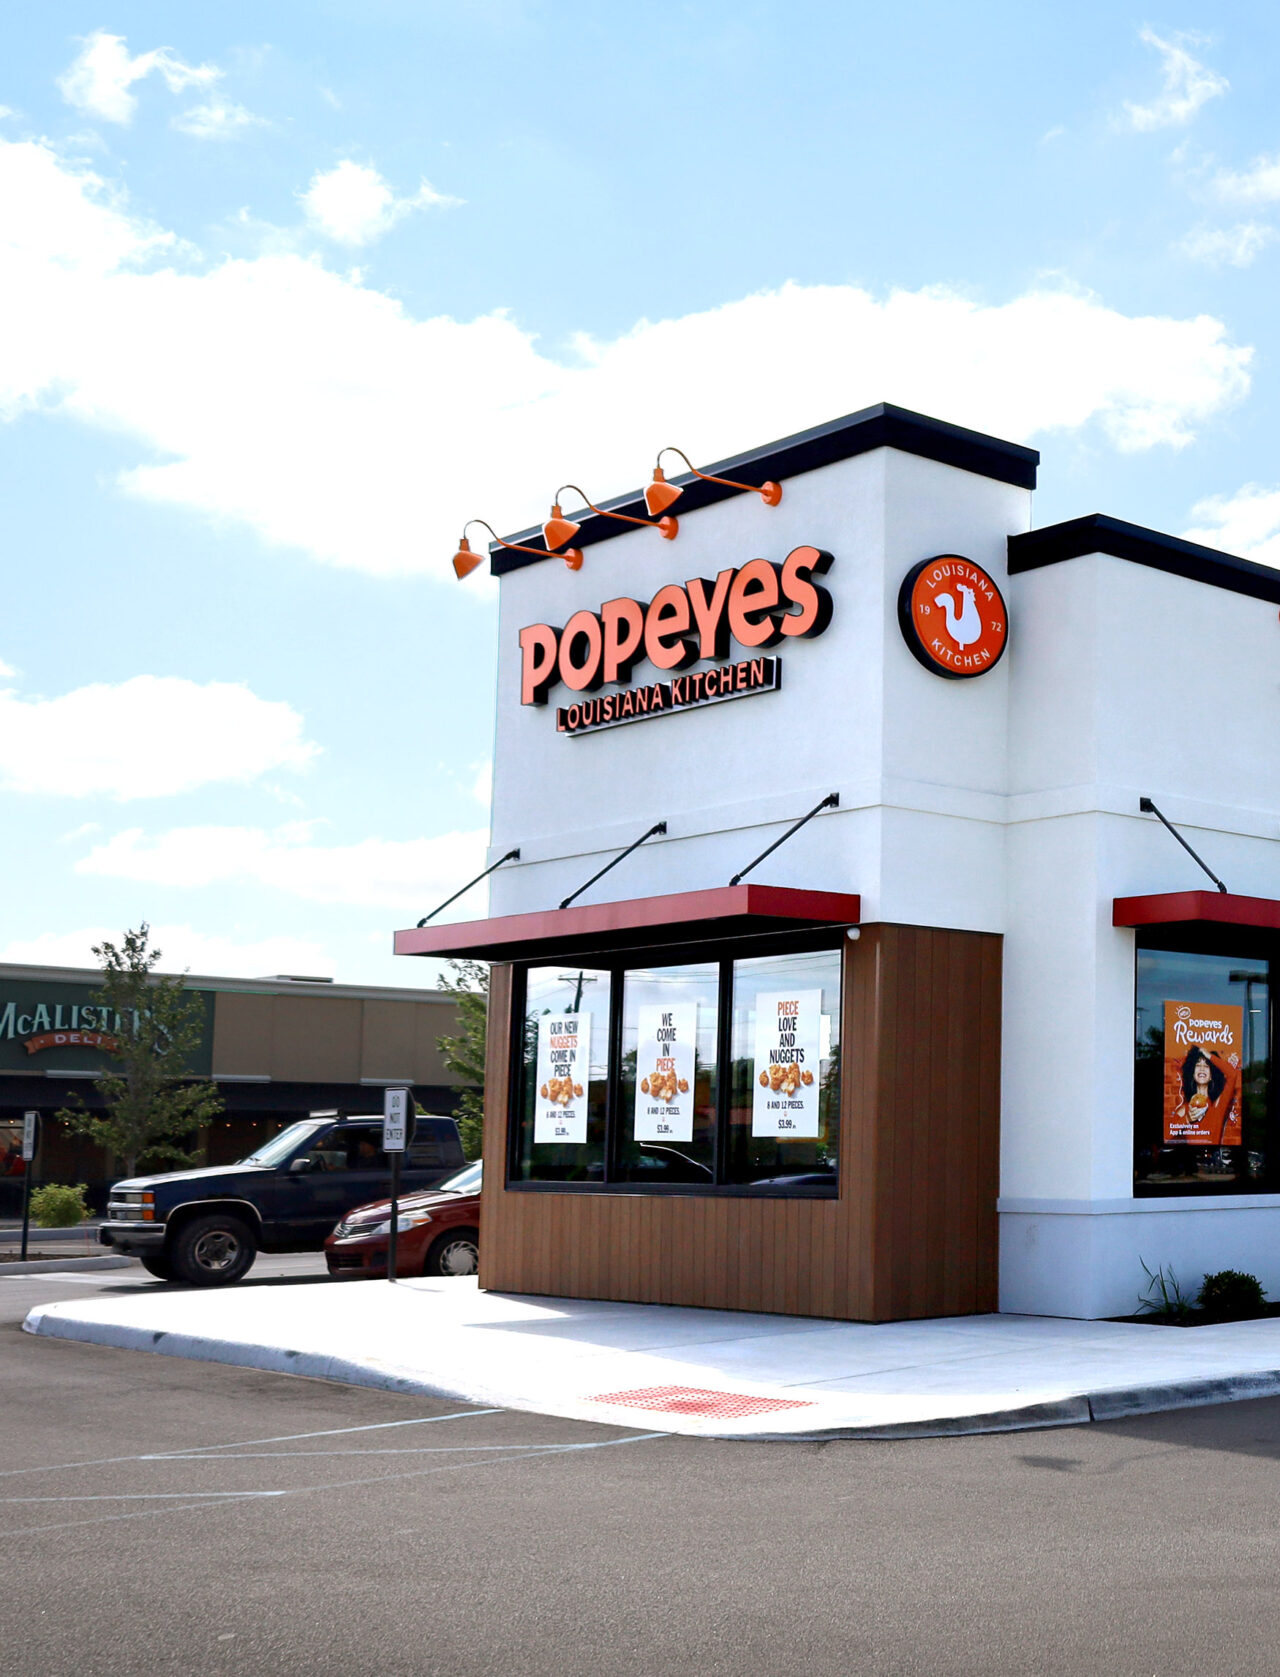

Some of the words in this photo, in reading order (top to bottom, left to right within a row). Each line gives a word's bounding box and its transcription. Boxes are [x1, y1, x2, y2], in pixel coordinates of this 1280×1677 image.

[926, 565, 994, 602] LOUISIANA
[920, 604, 931, 615] 19
[991, 621, 1002, 632] 72
[931, 638, 991, 667] KITCHEN
[556, 682, 668, 732] LOUISIANA
[671, 656, 768, 704] KITCHEN
[777, 1000, 799, 1016] PIECE
[662, 1012, 673, 1027] WE
[778, 1016, 797, 1032] LOVE
[550, 1021, 562, 1035] OUR
[564, 1020, 578, 1034] NEW
[656, 1028, 677, 1042] COME
[1173, 1020, 1234, 1046] Rewards
[54, 1033, 102, 1045] DELI
[550, 1035, 577, 1049] NUGGETS
[779, 1032, 796, 1048] AND
[550, 1049, 568, 1063] COME
[569, 1049, 576, 1063] IN
[662, 1043, 670, 1057] IN
[769, 1048, 805, 1064] NUGGETS
[554, 1063, 571, 1077] PIECE
[656, 1057, 676, 1072] PIECE
[771, 1101, 780, 1109] AND
[778, 1119, 792, 1129] $3.99
